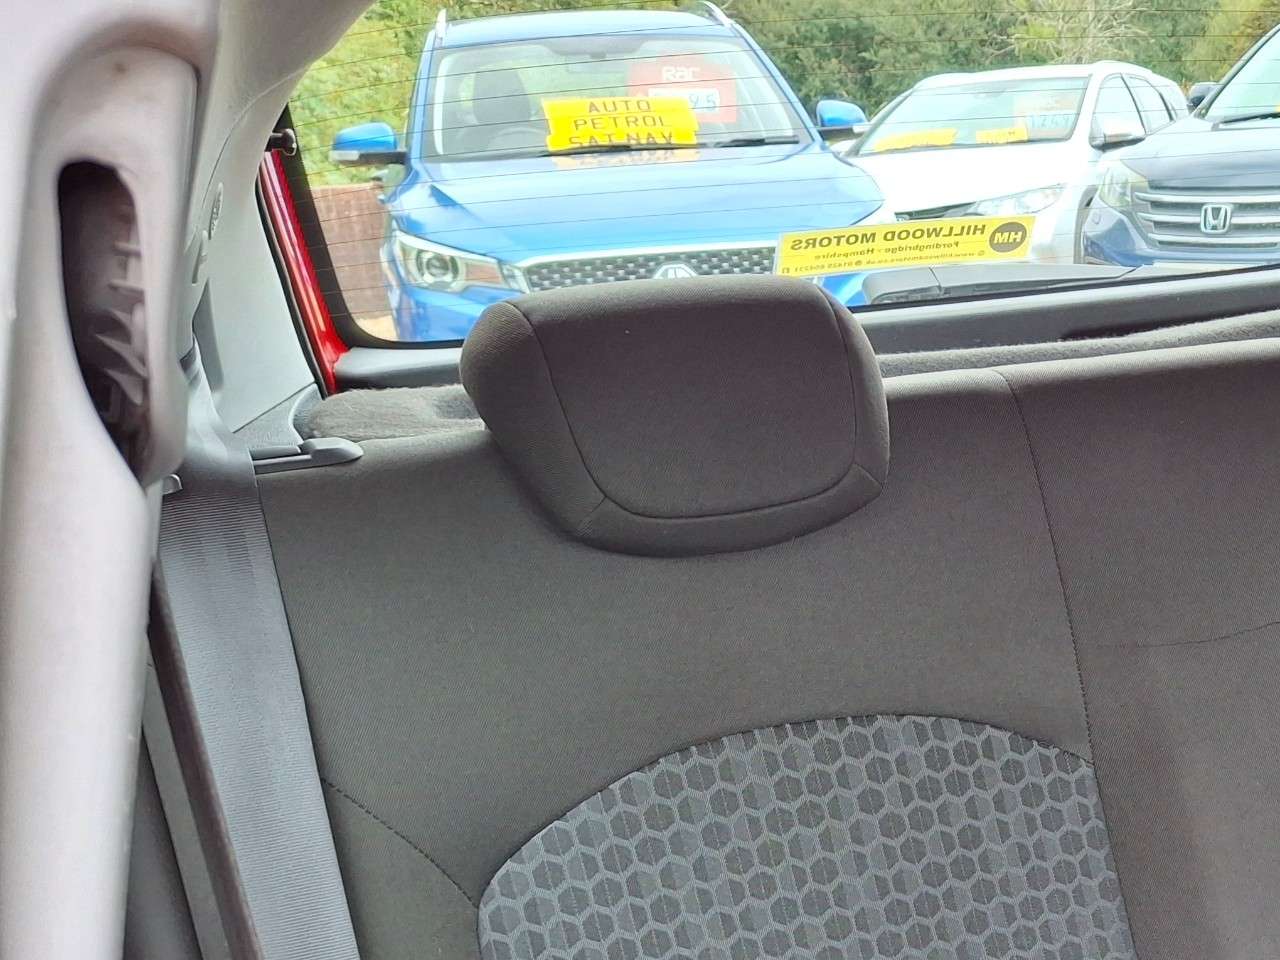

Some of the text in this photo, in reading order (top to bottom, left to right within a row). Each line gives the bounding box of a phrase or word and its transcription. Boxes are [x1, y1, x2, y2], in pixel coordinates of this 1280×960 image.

[587, 100, 651, 113] AUTO
[573, 115, 668, 131] PETROL
[569, 131, 673, 147] SAT NAV
